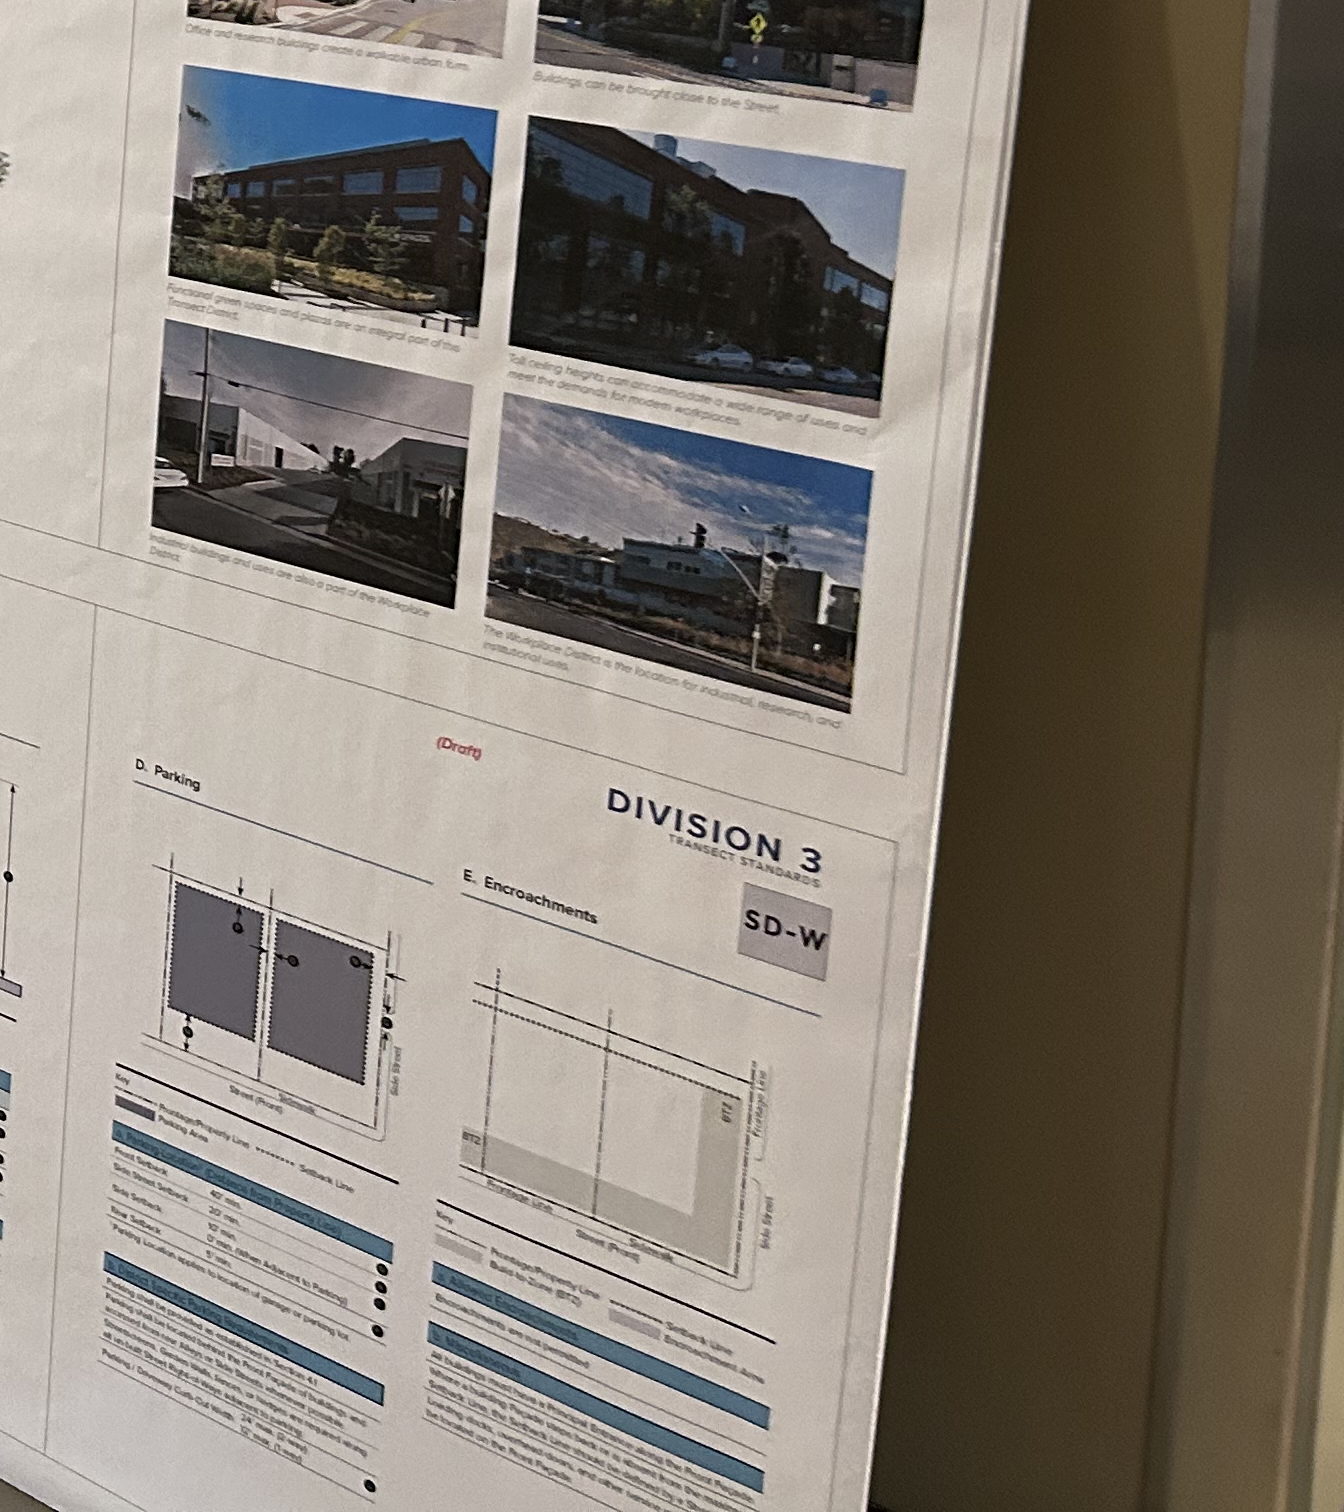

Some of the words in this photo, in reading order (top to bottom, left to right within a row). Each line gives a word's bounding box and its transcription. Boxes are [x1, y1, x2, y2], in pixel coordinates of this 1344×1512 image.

[436, 736, 482, 761] (Draft)
[136, 758, 148, 771] D.
[154, 765, 200, 793] Parking
[608, 789, 780, 862] DIVISION
[800, 847, 822, 873] 3
[668, 833, 736, 861] TRANSECT
[740, 855, 822, 888] STANDARDS
[464, 868, 476, 884] E.
[484, 875, 598, 924] Encroachments
[744, 909, 828, 951] SD-W
